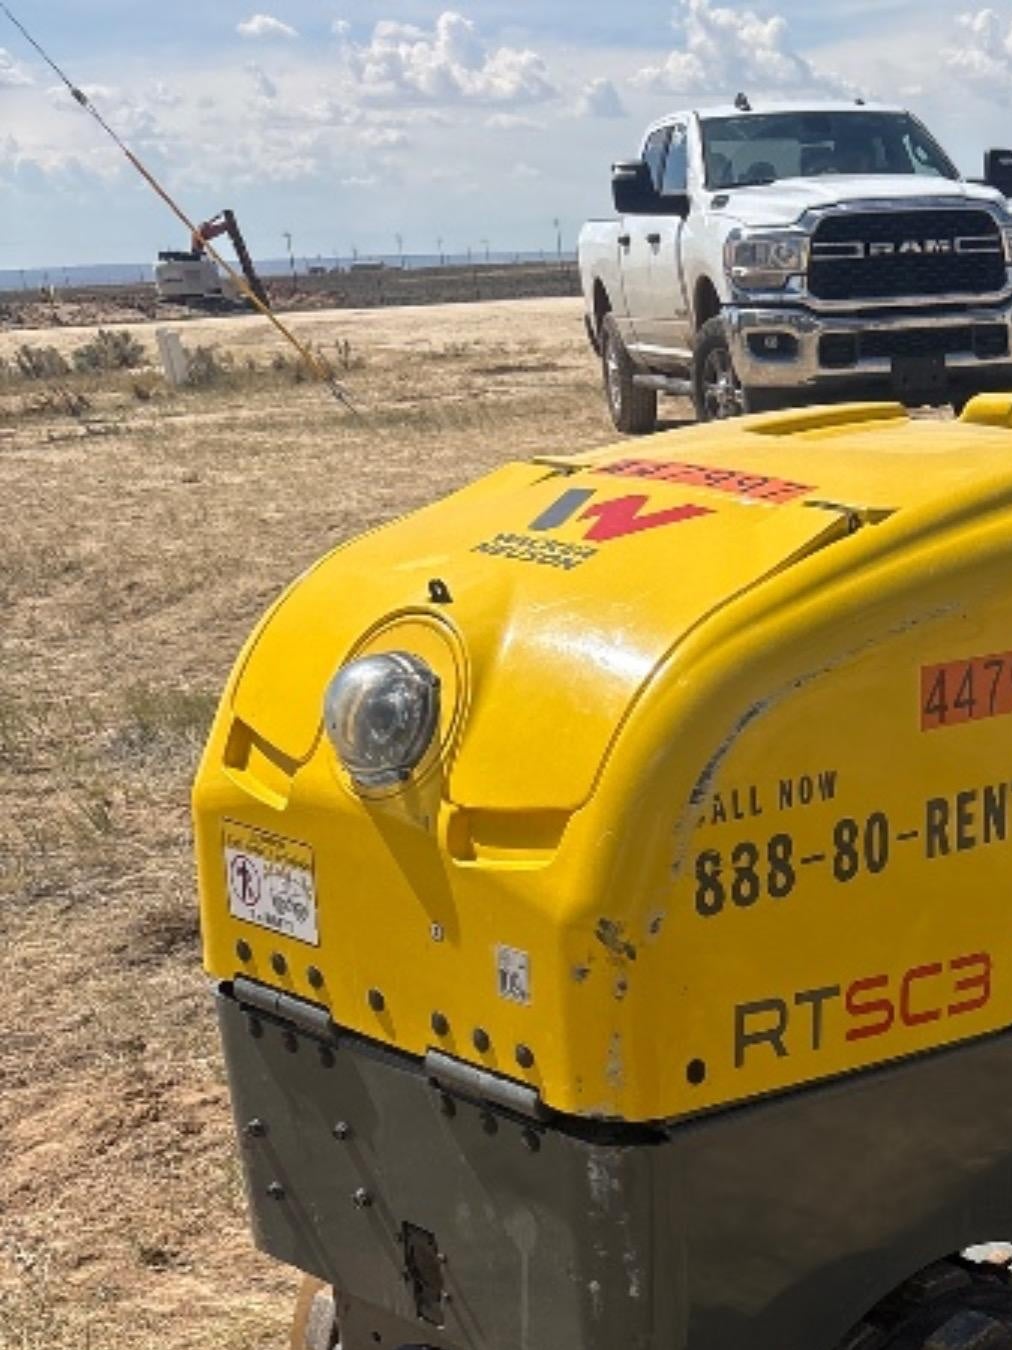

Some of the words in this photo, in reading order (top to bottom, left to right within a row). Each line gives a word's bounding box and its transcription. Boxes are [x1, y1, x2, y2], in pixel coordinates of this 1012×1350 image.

[869, 239, 951, 257] RAM
[697, 785, 763, 829] ALL
[778, 770, 838, 811] NOW
[734, 951, 993, 1069] RTSC3
